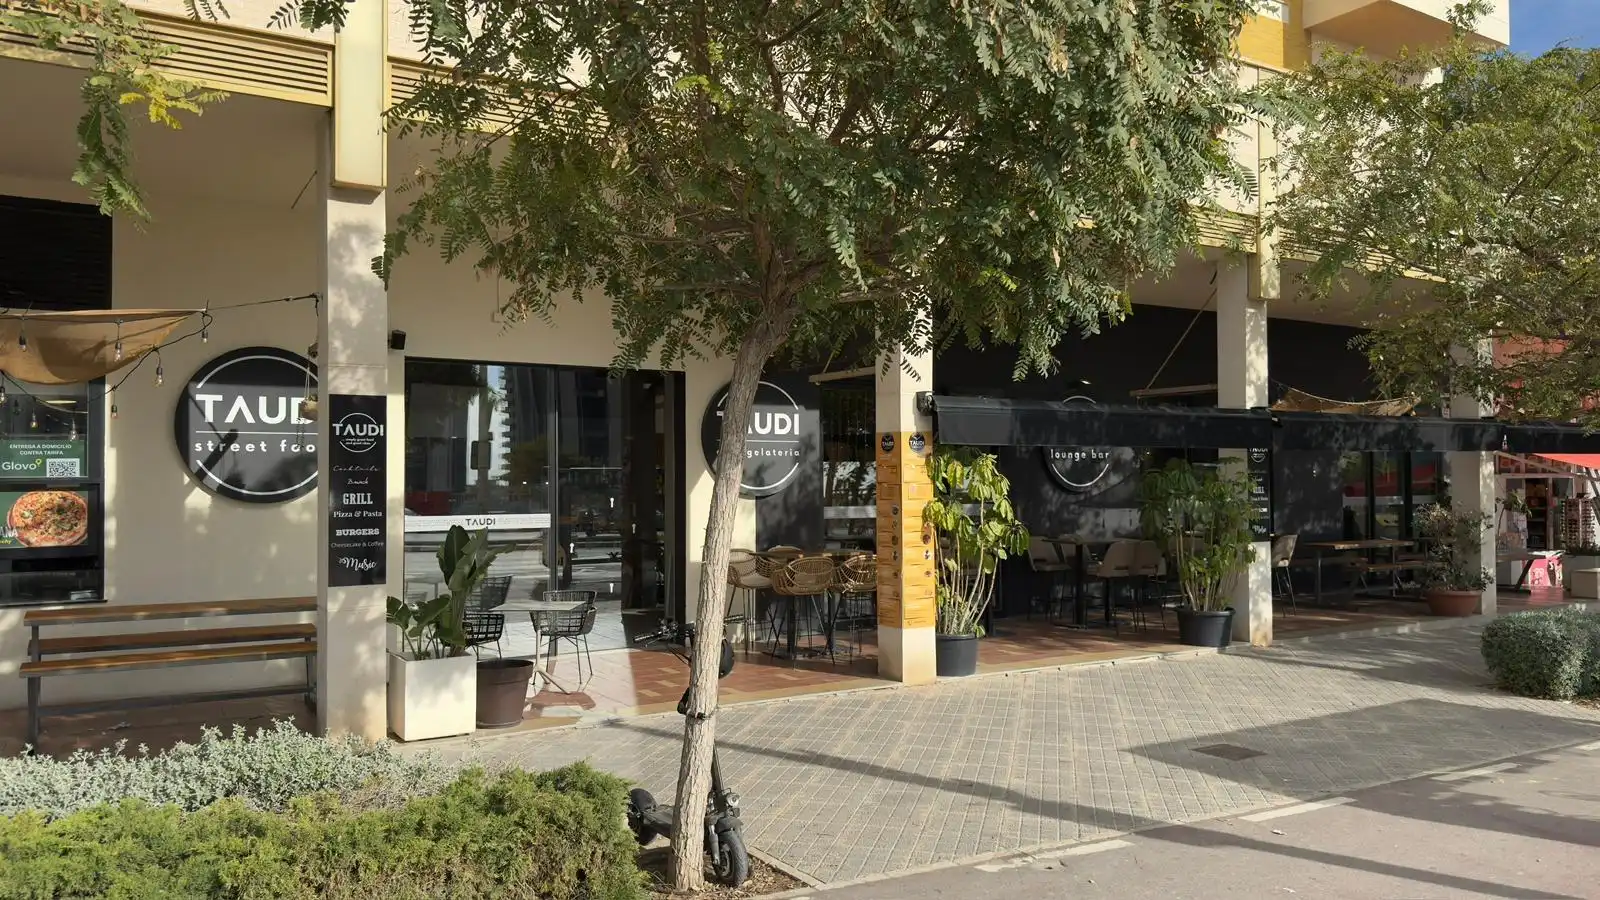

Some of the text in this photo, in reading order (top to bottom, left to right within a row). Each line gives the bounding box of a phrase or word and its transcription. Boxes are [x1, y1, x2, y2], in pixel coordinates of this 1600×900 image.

[195, 394, 317, 425] TAUD
[332, 423, 384, 437] TAUDI
[194, 439, 317, 453] street foo
[746, 448, 800, 459] gelateria
[1050, 448, 1110, 462] lounge bar
[1, 461, 37, 471] Glovo
[343, 492, 374, 505] GRILL
[333, 510, 353, 518] Pizza
[354, 510, 362, 518] &
[465, 517, 496, 526] TAUDI
[335, 528, 380, 536] BURGERS
